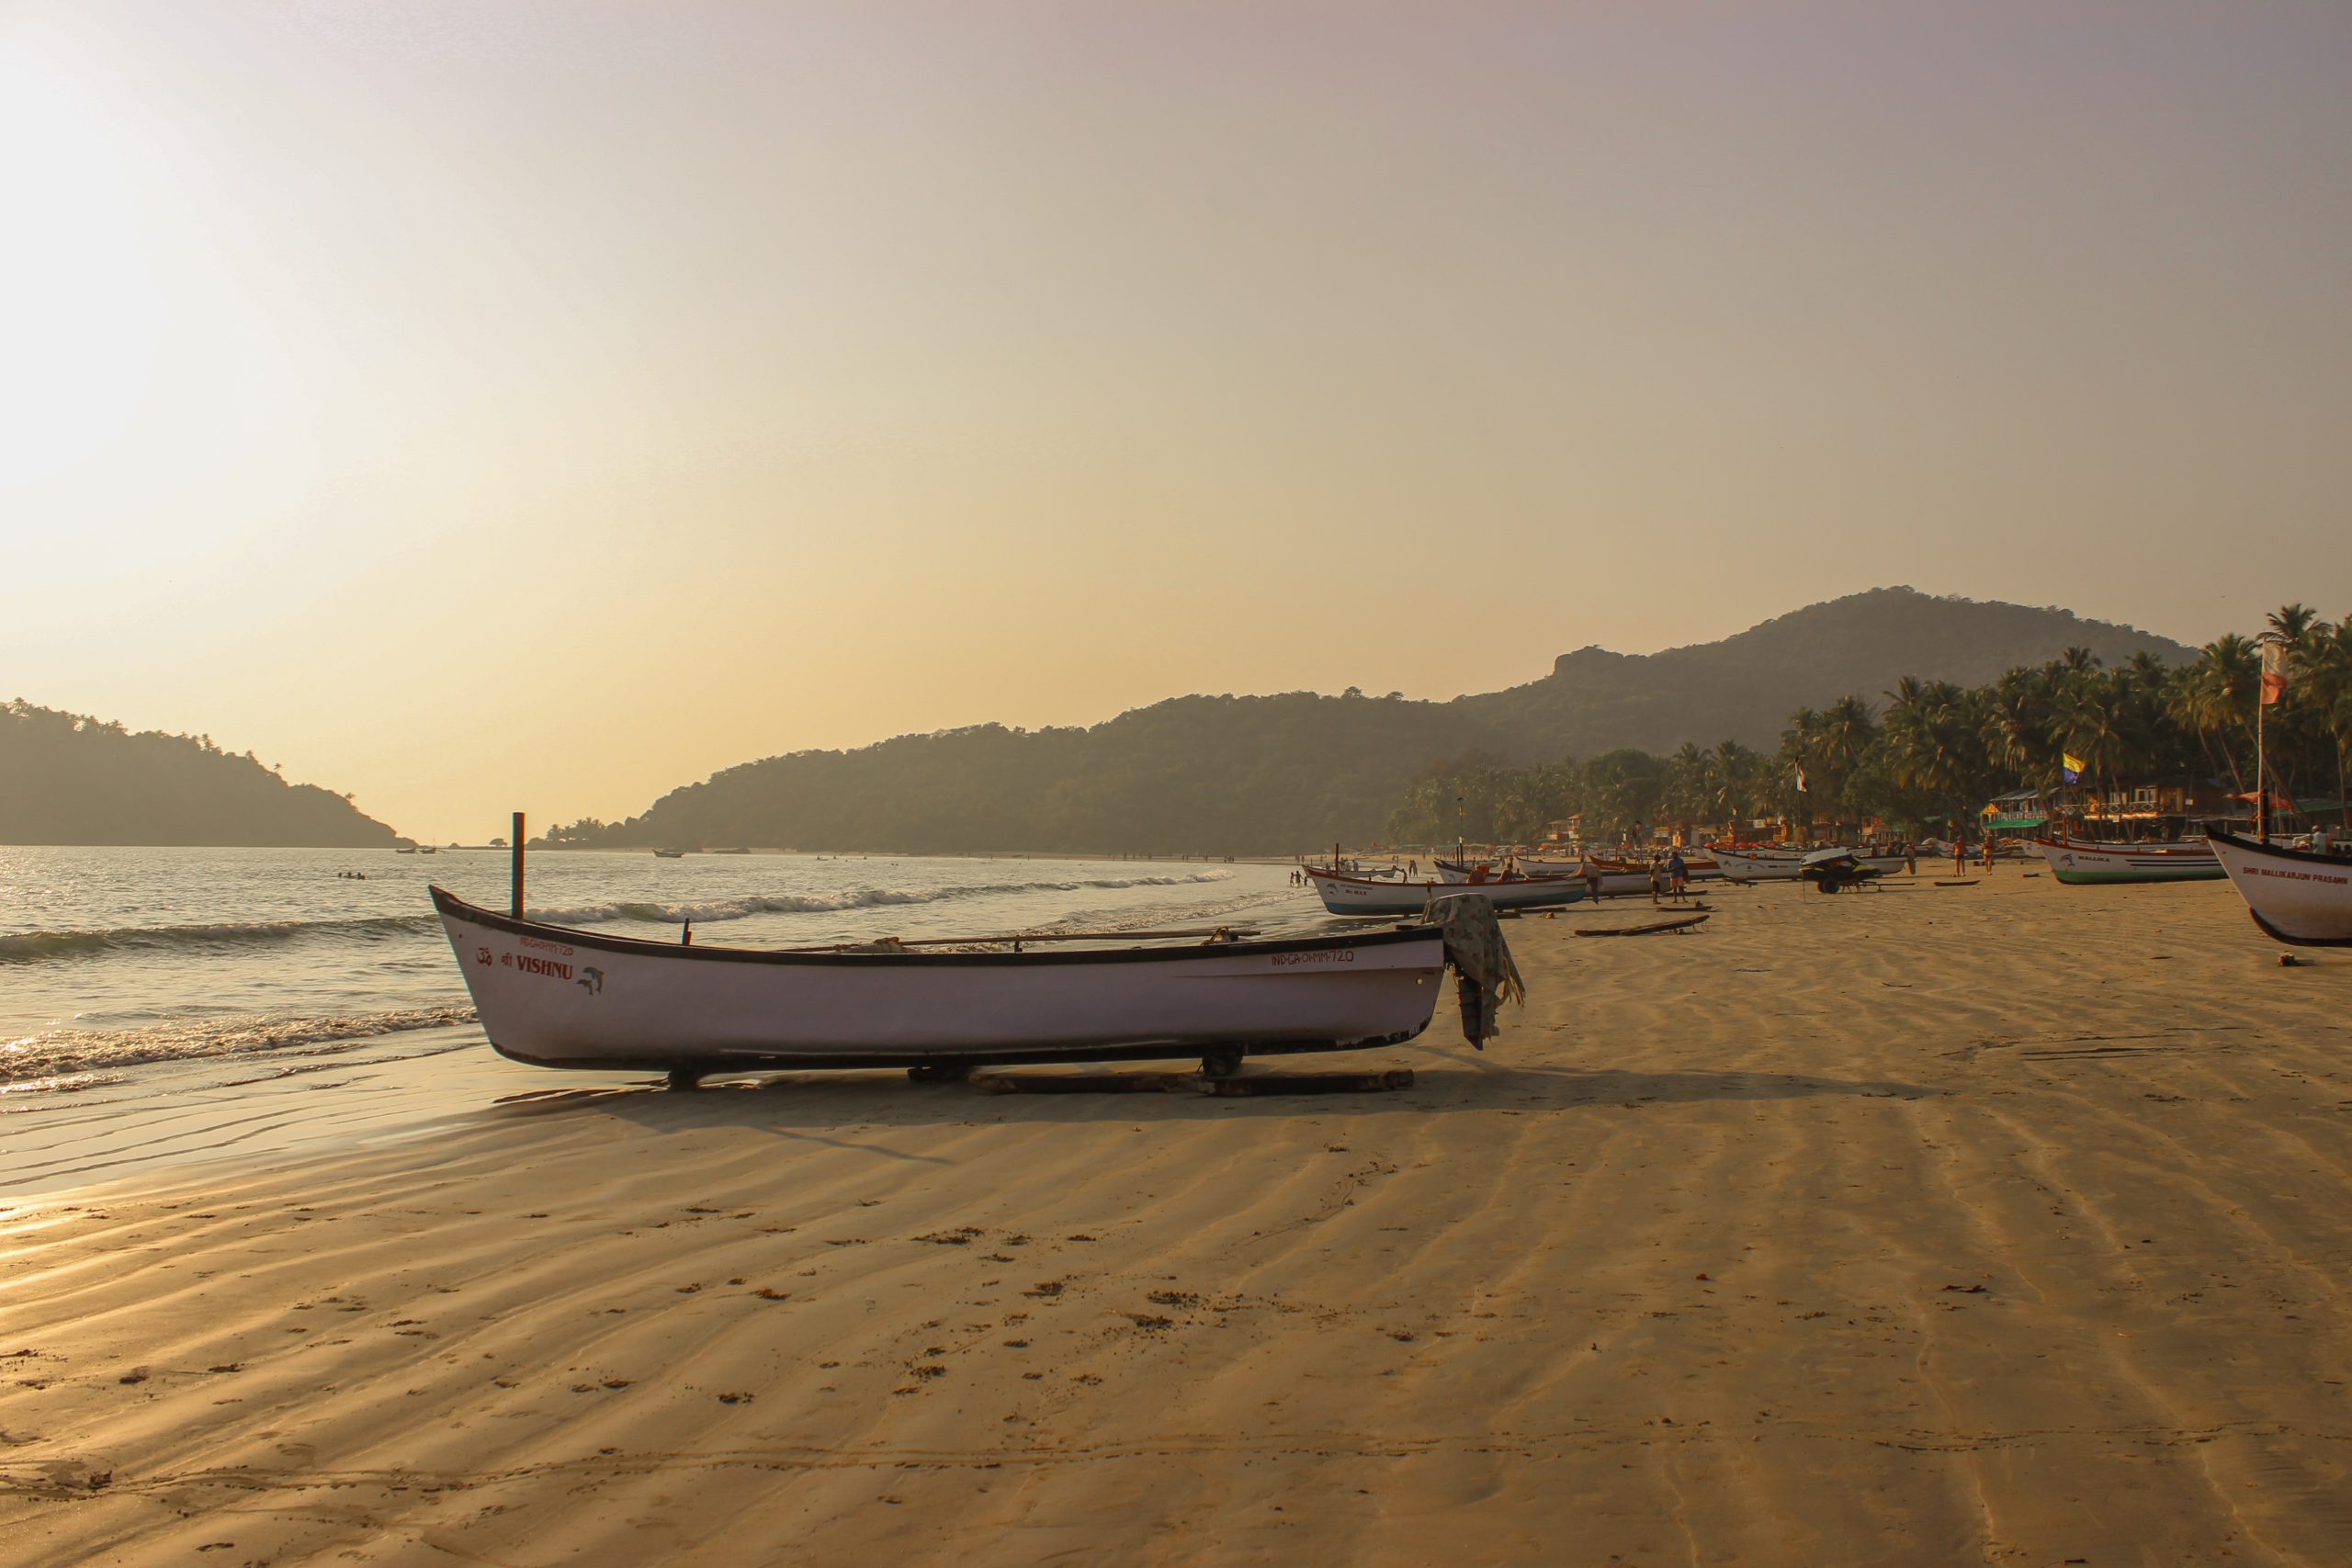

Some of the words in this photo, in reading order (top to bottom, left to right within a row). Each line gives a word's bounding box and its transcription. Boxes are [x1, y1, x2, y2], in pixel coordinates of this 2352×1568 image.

[2243, 866, 2259, 875] SHRI
[2261, 868, 2311, 881] MALLIKARJUN
[516, 954, 573, 980] VISHNU
